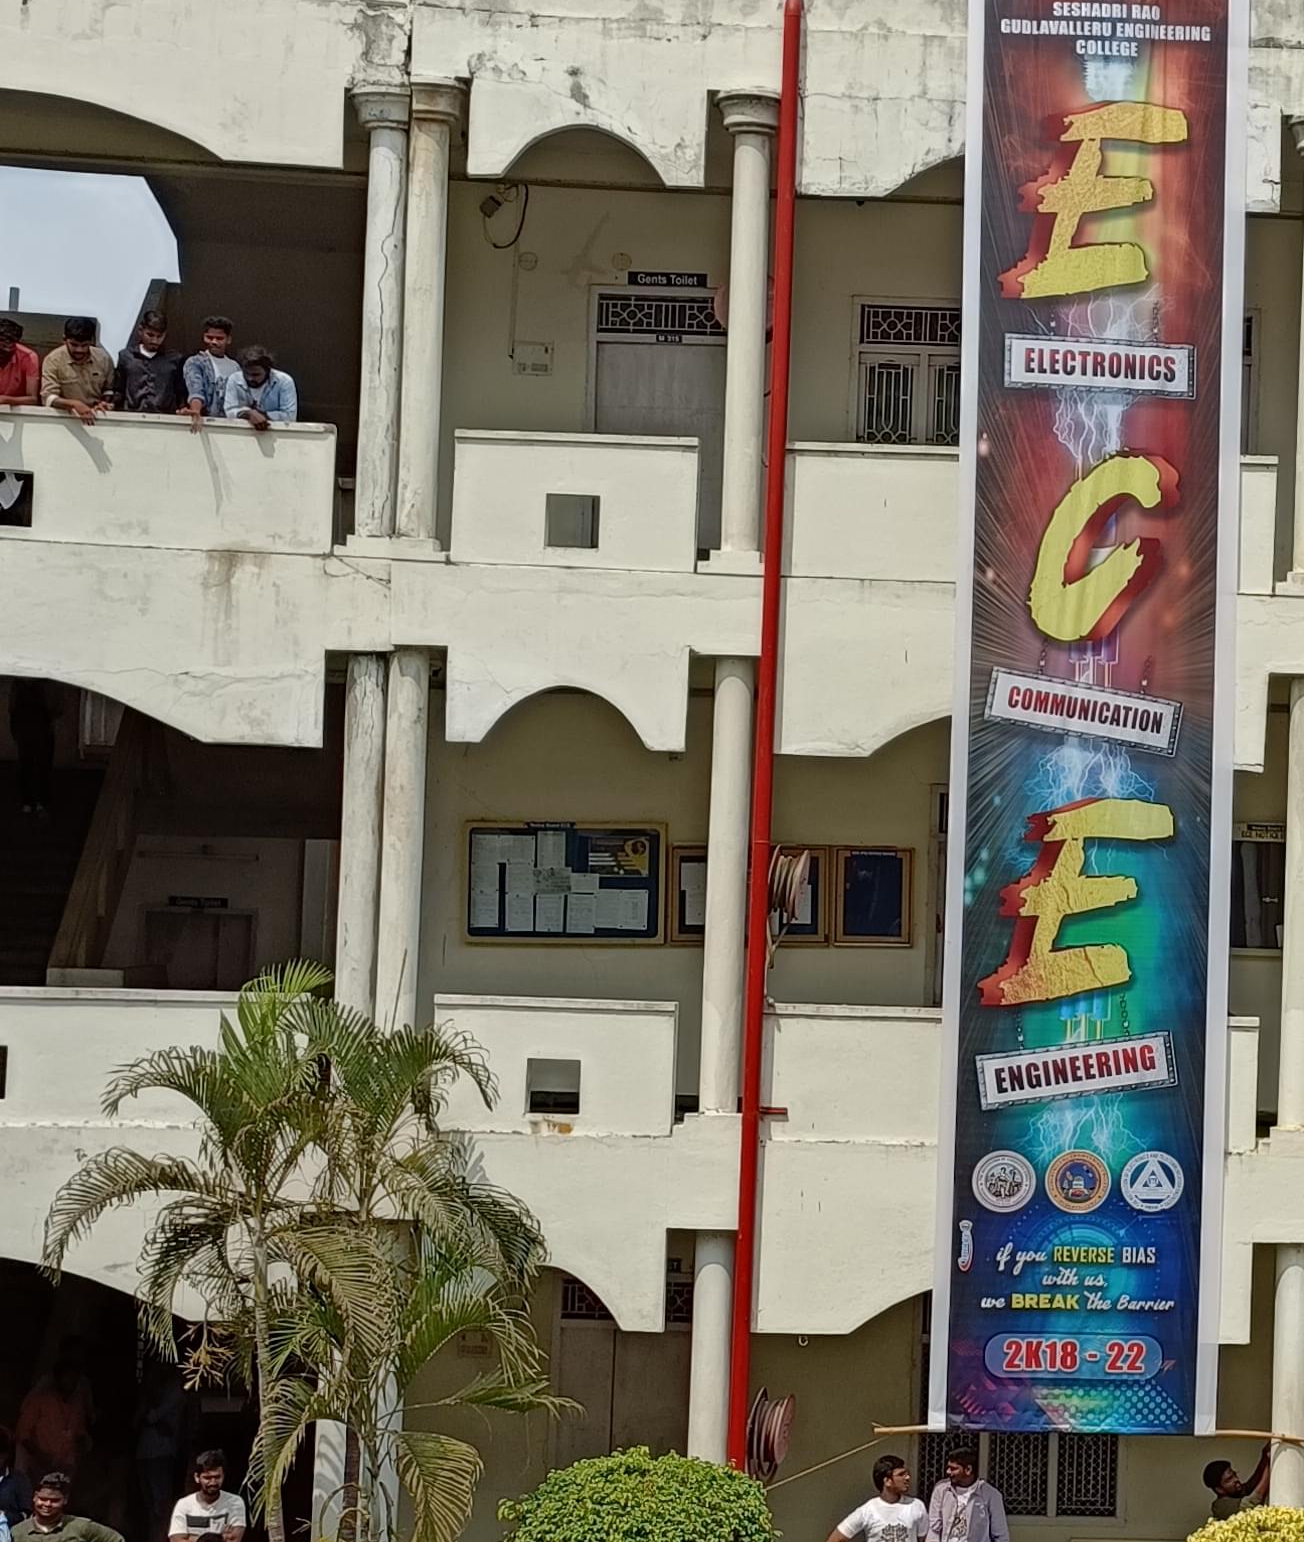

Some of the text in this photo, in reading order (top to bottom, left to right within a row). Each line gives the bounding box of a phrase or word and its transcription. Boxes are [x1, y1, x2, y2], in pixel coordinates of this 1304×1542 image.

[1052, 2, 1161, 20] SESHADRI RAO
[1000, 19, 1212, 41] GUDLAVALLERU ENGINEERING
[1076, 40, 1138, 57] COLLEGE
[1014, 101, 1188, 299] E
[637, 273, 698, 285] Gents Toilet
[1024, 347, 1177, 383] ELECTRONICS
[1008, 685, 1164, 734] COMMUNICATION
[998, 798, 1175, 1007] E
[994, 1044, 1157, 1094] ENGINEERING
[996, 1242, 1013, 1271] if
[1016, 1250, 1048, 1275] you
[1053, 1245, 1115, 1264] REVERSE
[1122, 1246, 1156, 1264] BIAS
[1042, 1267, 1079, 1287] with
[981, 1291, 1175, 1311] we BREAK the Barrier
[1003, 1338, 1079, 1371] 2K18
[1105, 1339, 1146, 1373] 22
